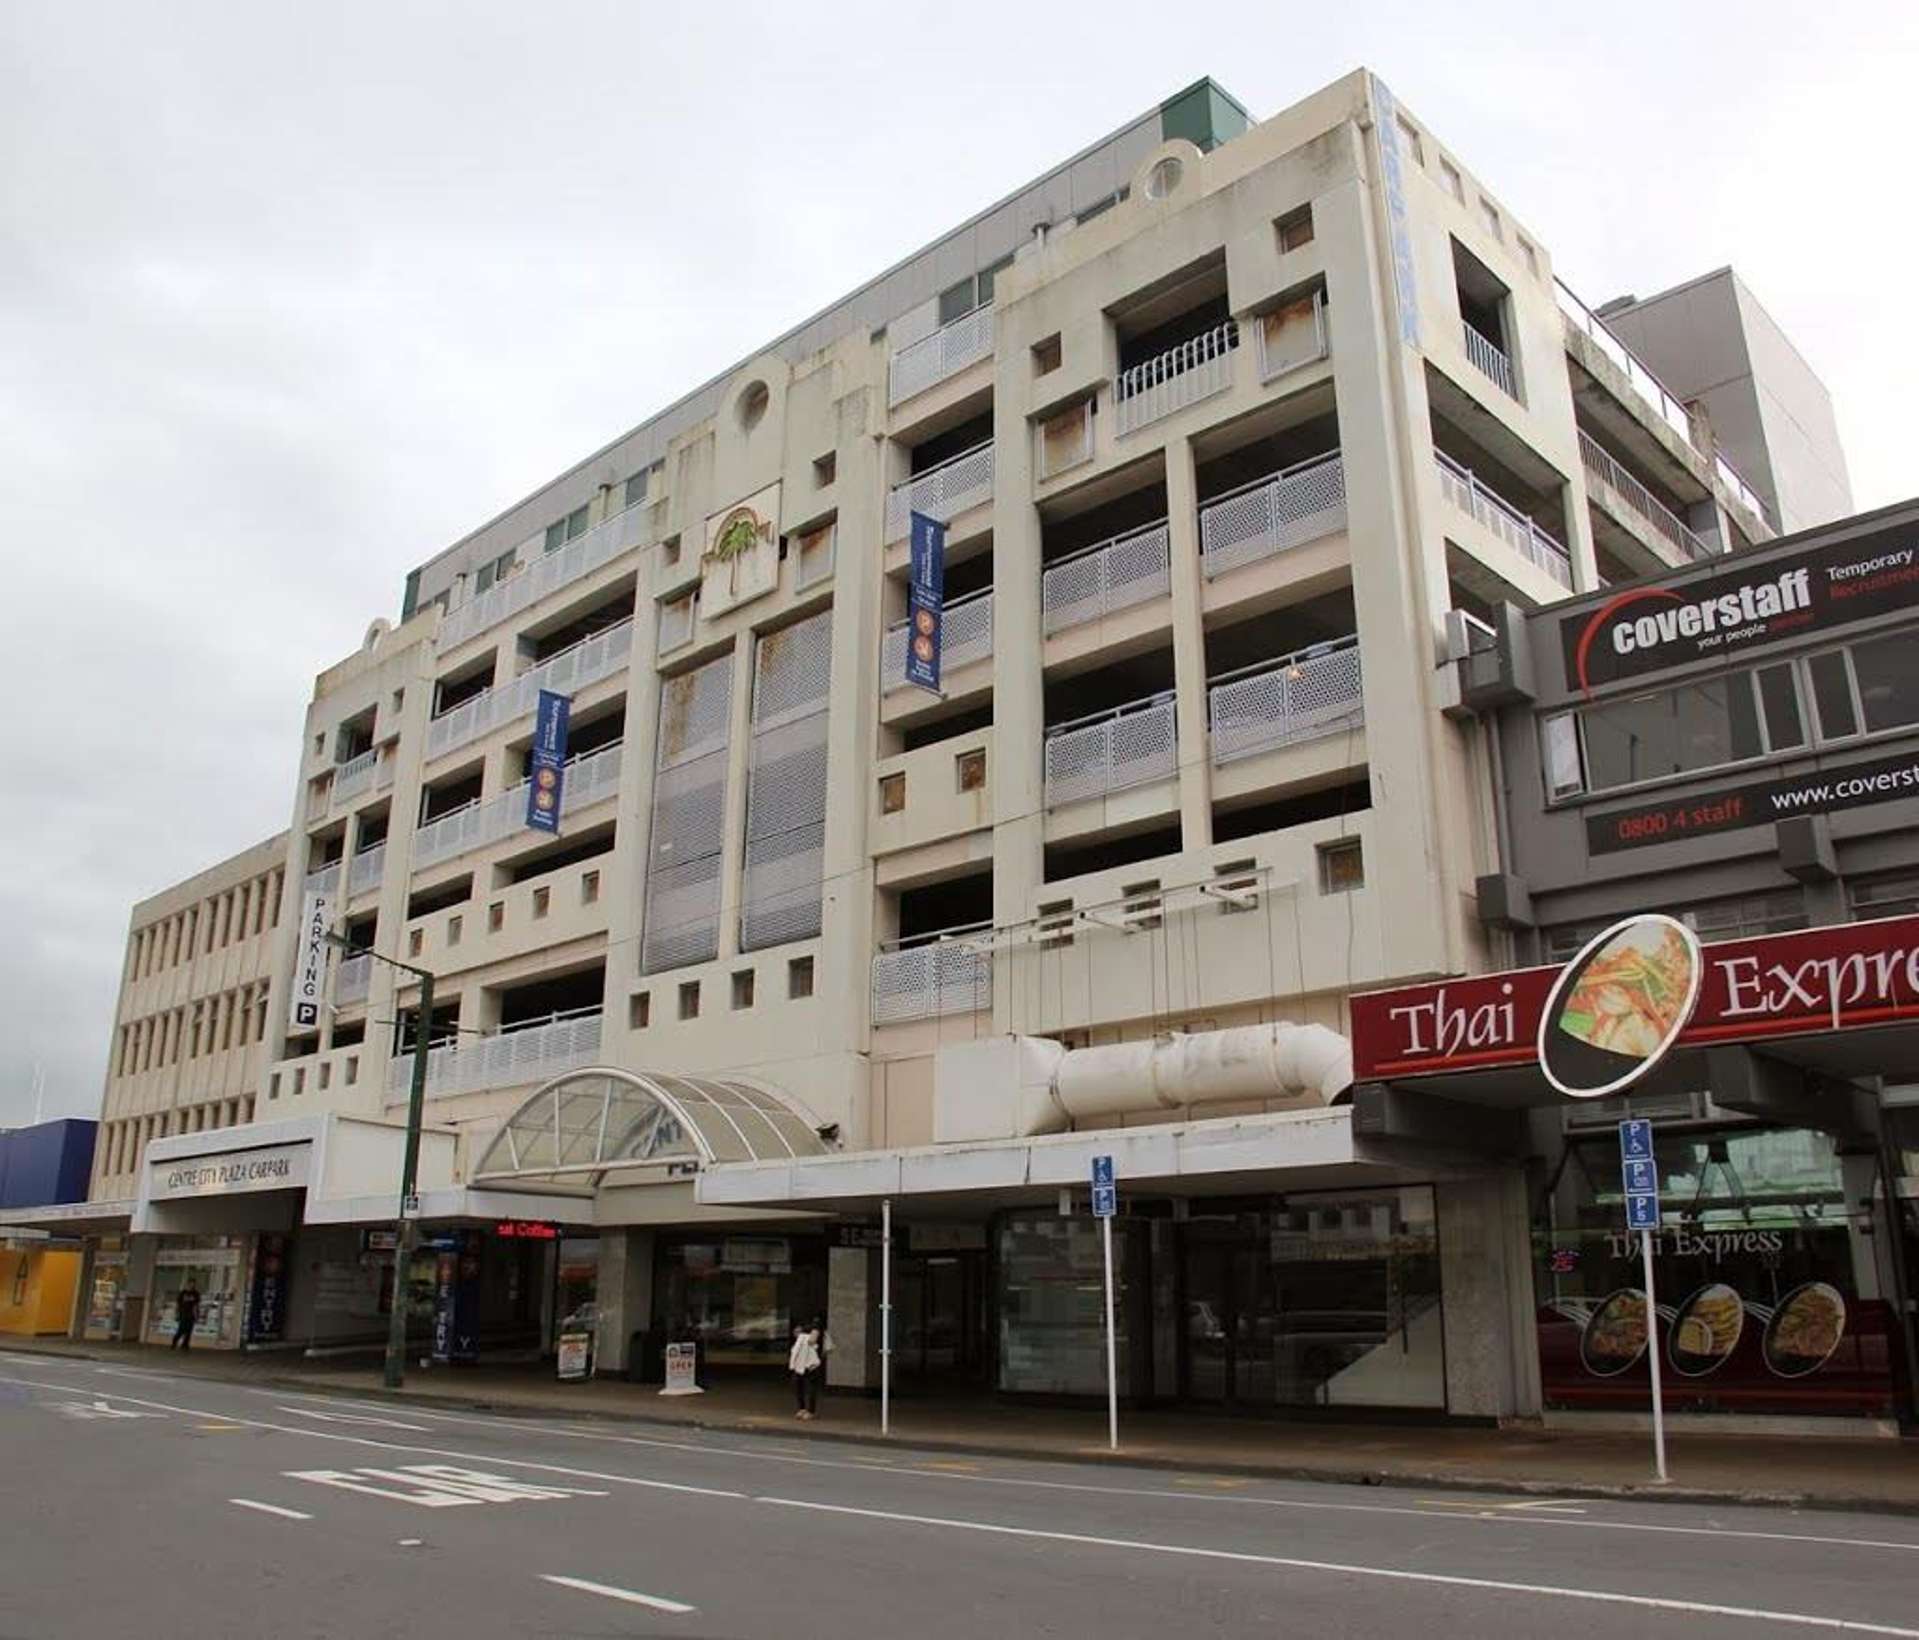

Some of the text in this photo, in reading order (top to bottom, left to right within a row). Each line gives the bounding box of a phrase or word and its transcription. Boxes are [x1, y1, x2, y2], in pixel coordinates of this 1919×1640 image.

[1825, 549, 1913, 581] Temporary
[1612, 567, 1811, 655] coverstaff
[1697, 631, 1722, 651] your
[1725, 622, 1767, 644] people
[1618, 798, 1742, 840] 0800 4 staff
[304, 898, 325, 996] PARKING
[1389, 981, 1515, 1059] Thai
[1630, 1124, 1641, 1136] P
[168, 1158, 291, 1189] CENTRE CITY PLAZA CARPARK
[1633, 1164, 1645, 1176] P
[1637, 1198, 1647, 1209] P
[1673, 1229, 1783, 1264] Express
